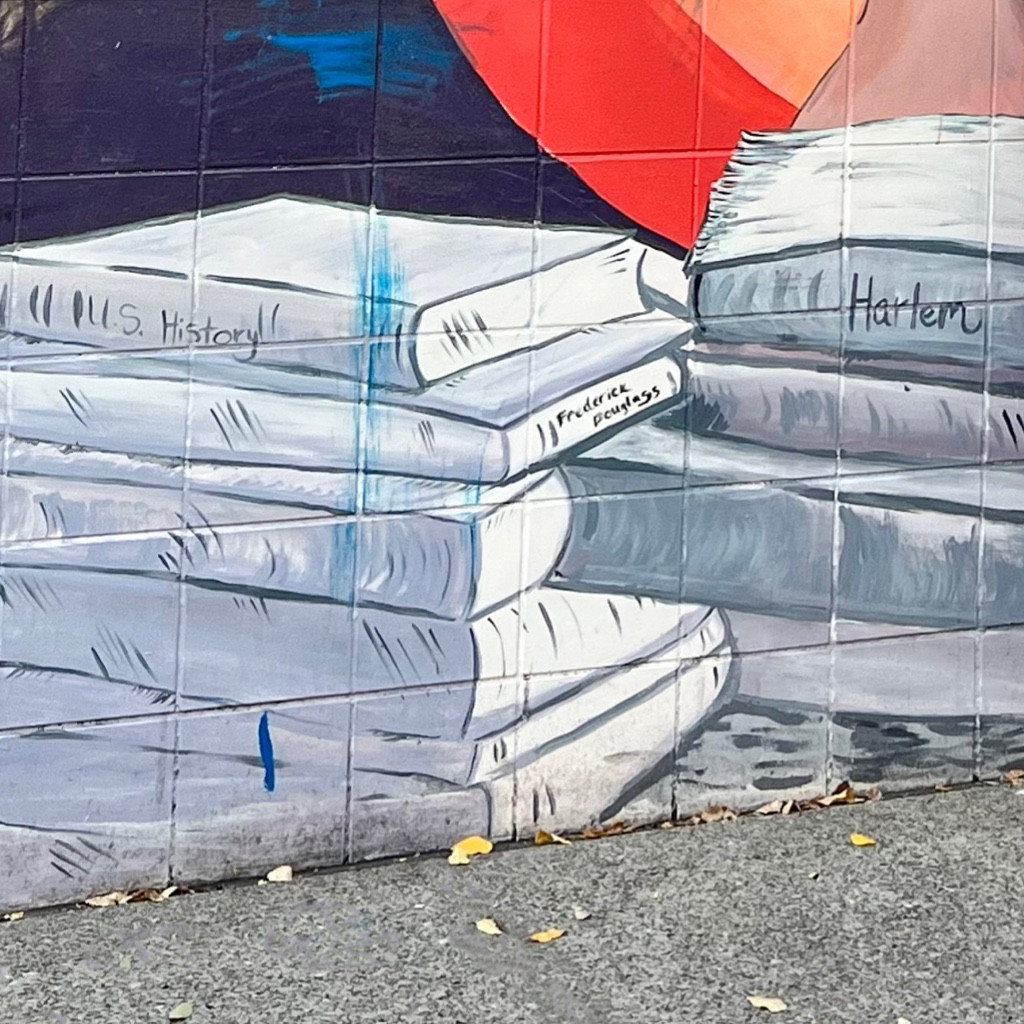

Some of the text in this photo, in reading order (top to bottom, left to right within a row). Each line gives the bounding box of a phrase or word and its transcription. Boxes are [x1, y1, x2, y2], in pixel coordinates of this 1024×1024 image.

[88, 295, 260, 363] U.S. History
[849, 272, 982, 335] Harlem
[556, 382, 632, 428] Frederick
[592, 386, 661, 427] Douglass
